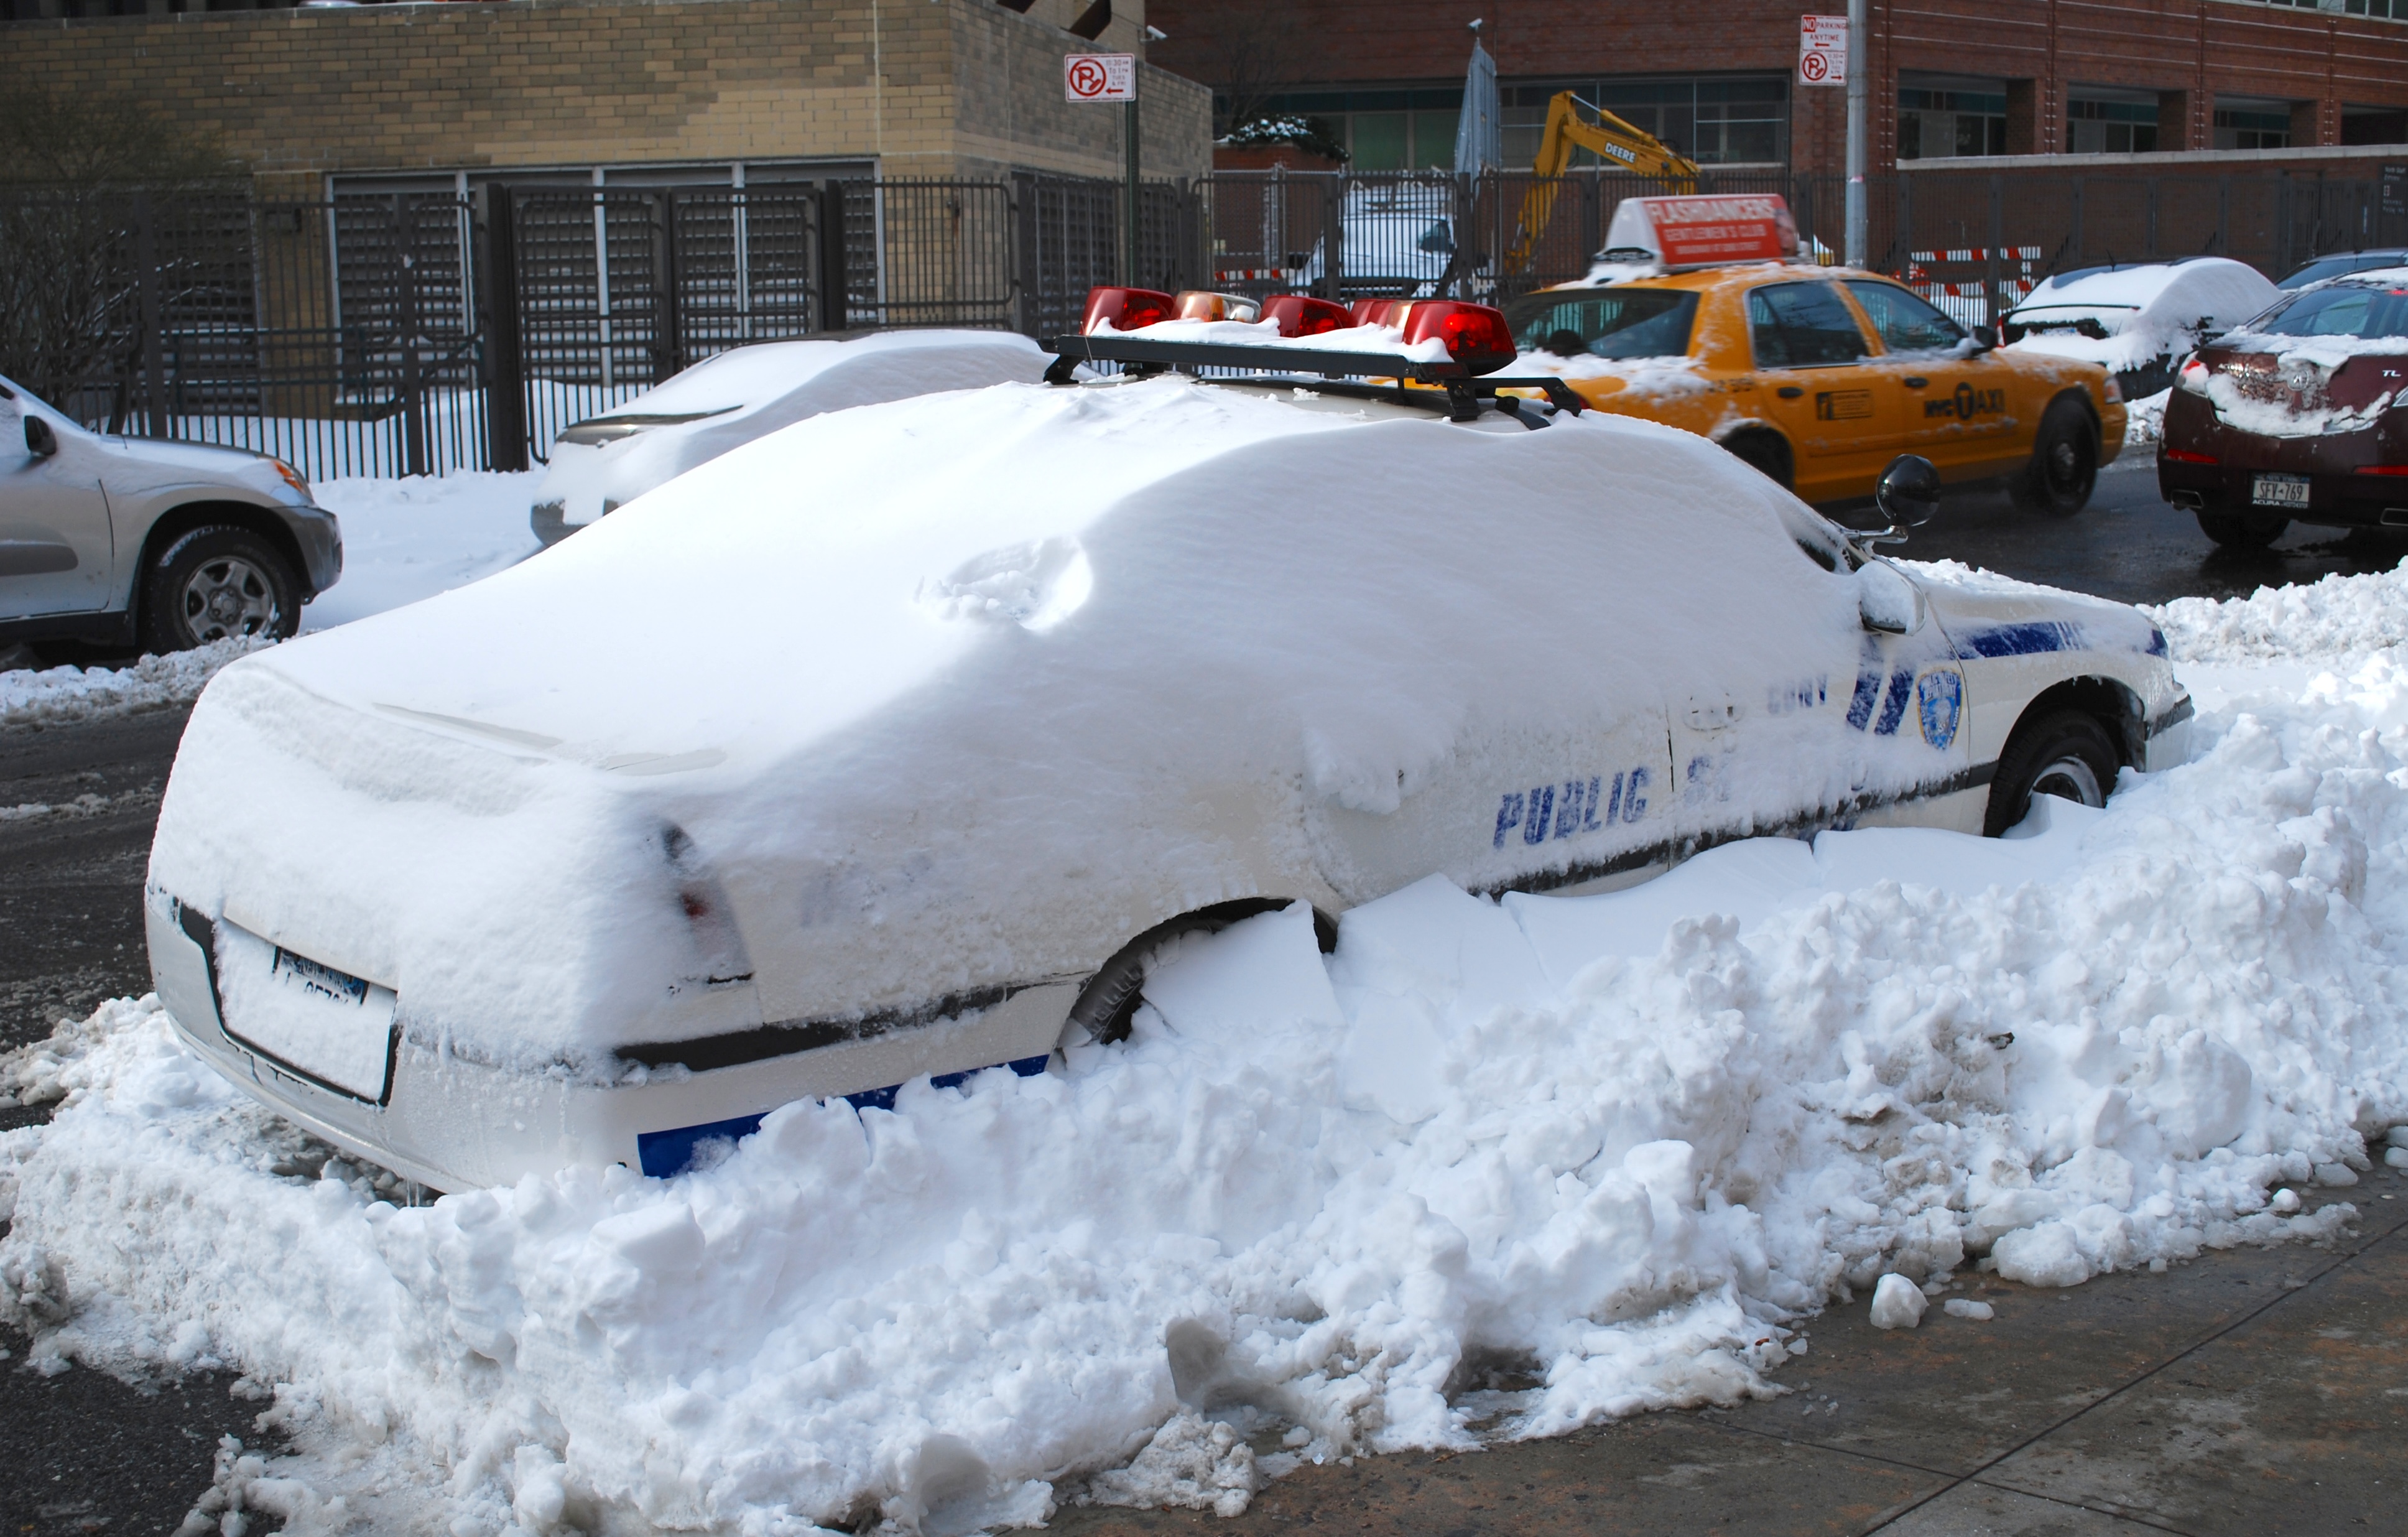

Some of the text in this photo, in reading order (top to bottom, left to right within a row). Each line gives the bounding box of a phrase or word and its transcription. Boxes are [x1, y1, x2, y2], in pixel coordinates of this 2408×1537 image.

[1804, 18, 1848, 30] NO PARKING
[1605, 142, 1636, 164] DEERE
[2383, 369, 2402, 378] TL
[1493, 766, 1652, 851] PUBLIC
